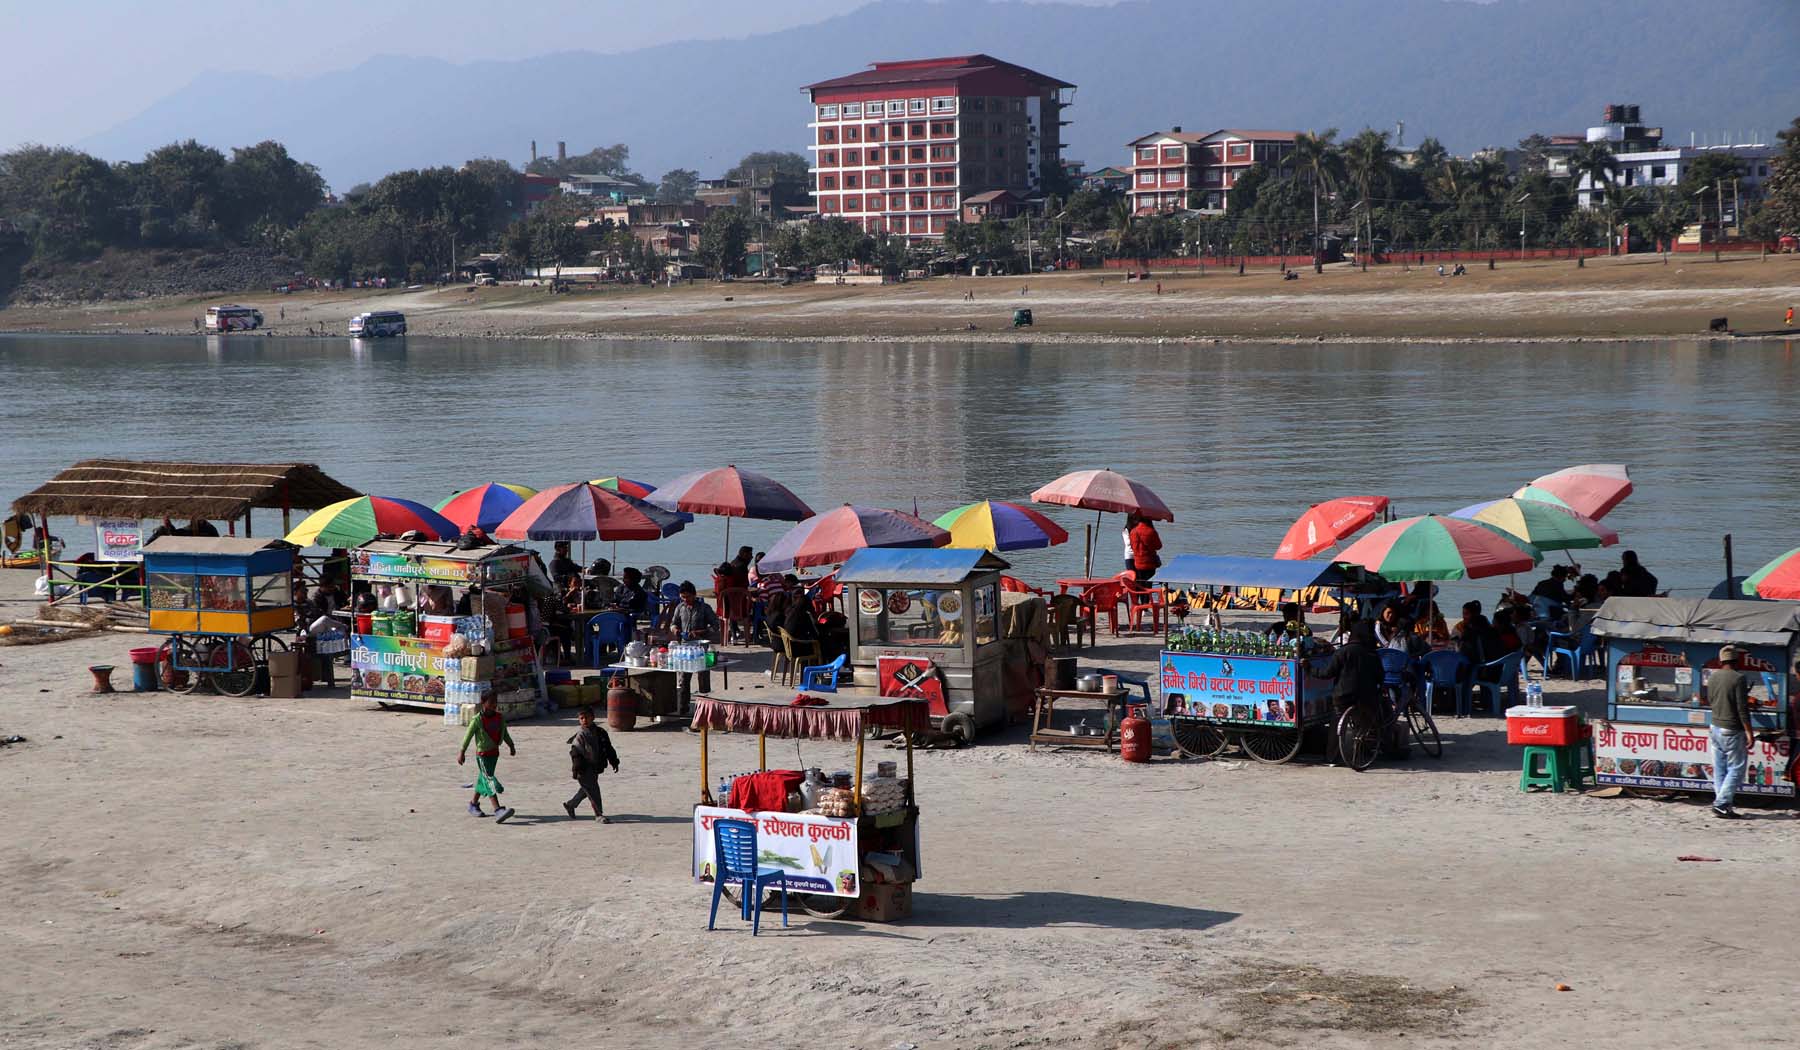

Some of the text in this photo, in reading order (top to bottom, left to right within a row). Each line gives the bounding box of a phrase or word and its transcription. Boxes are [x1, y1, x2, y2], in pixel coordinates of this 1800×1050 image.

[351, 646, 379, 665] पंडित
[384, 650, 427, 672] पानीपुरी
[1259, 677, 1294, 699] पानीपुरी
[1599, 722, 1618, 748] श्री
[1622, 731, 1658, 754] कृष्ण
[1663, 728, 1708, 752] चिकेन
[763, 816, 804, 838] स्पेशल
[808, 822, 851, 843] कुल्फी
